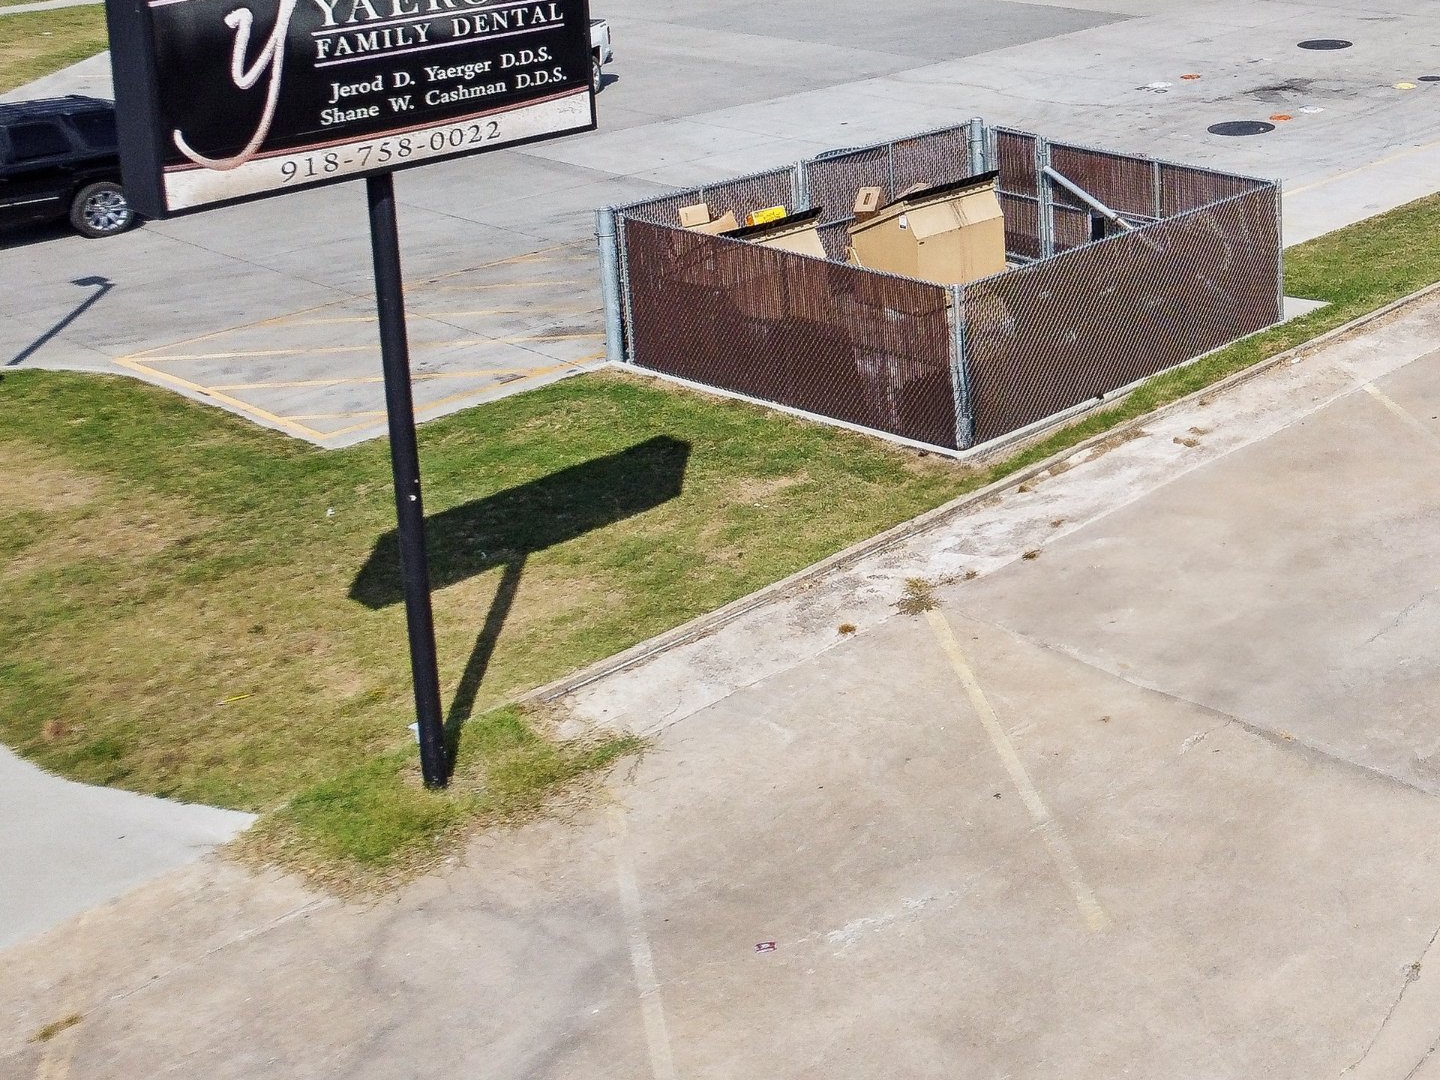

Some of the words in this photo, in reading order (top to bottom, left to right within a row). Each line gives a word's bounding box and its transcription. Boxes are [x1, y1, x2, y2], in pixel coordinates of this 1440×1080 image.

[313, 22, 432, 60] FAMILY
[450, 2, 564, 38] DENTAL
[320, 102, 380, 126] Shane
[388, 95, 415, 113] W.
[425, 80, 507, 106] Cashman
[515, 66, 568, 90] D.D.S.
[328, 75, 384, 104] Jerod
[393, 71, 416, 89] D.
[423, 58, 493, 83] Yaerger
[500, 46, 553, 69] D.D.S.
[281, 120, 501, 183] 918-758-0022
